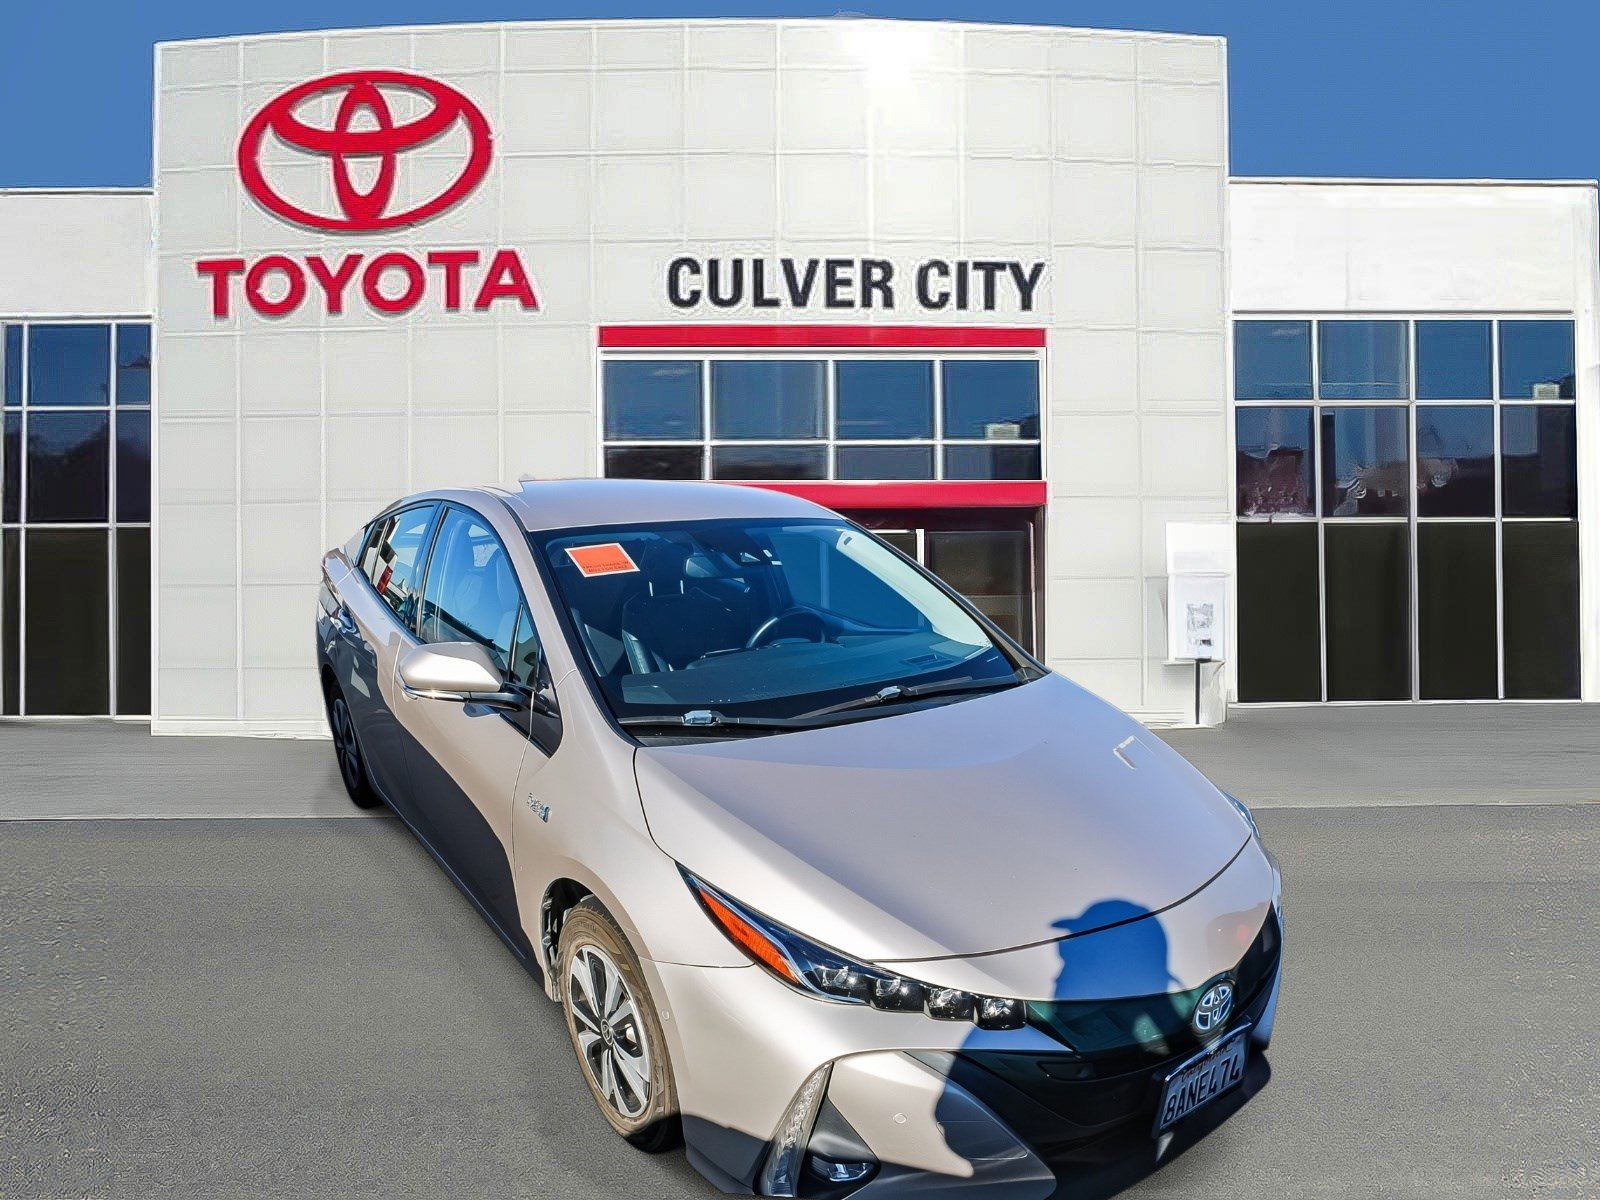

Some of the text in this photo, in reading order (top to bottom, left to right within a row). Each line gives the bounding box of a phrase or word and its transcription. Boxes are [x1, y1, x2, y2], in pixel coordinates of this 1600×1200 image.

[196, 250, 539, 319] TOYOTA
[668, 257, 1046, 311] CULVER CITY
[1163, 1053, 1240, 1124] 8ANE474
